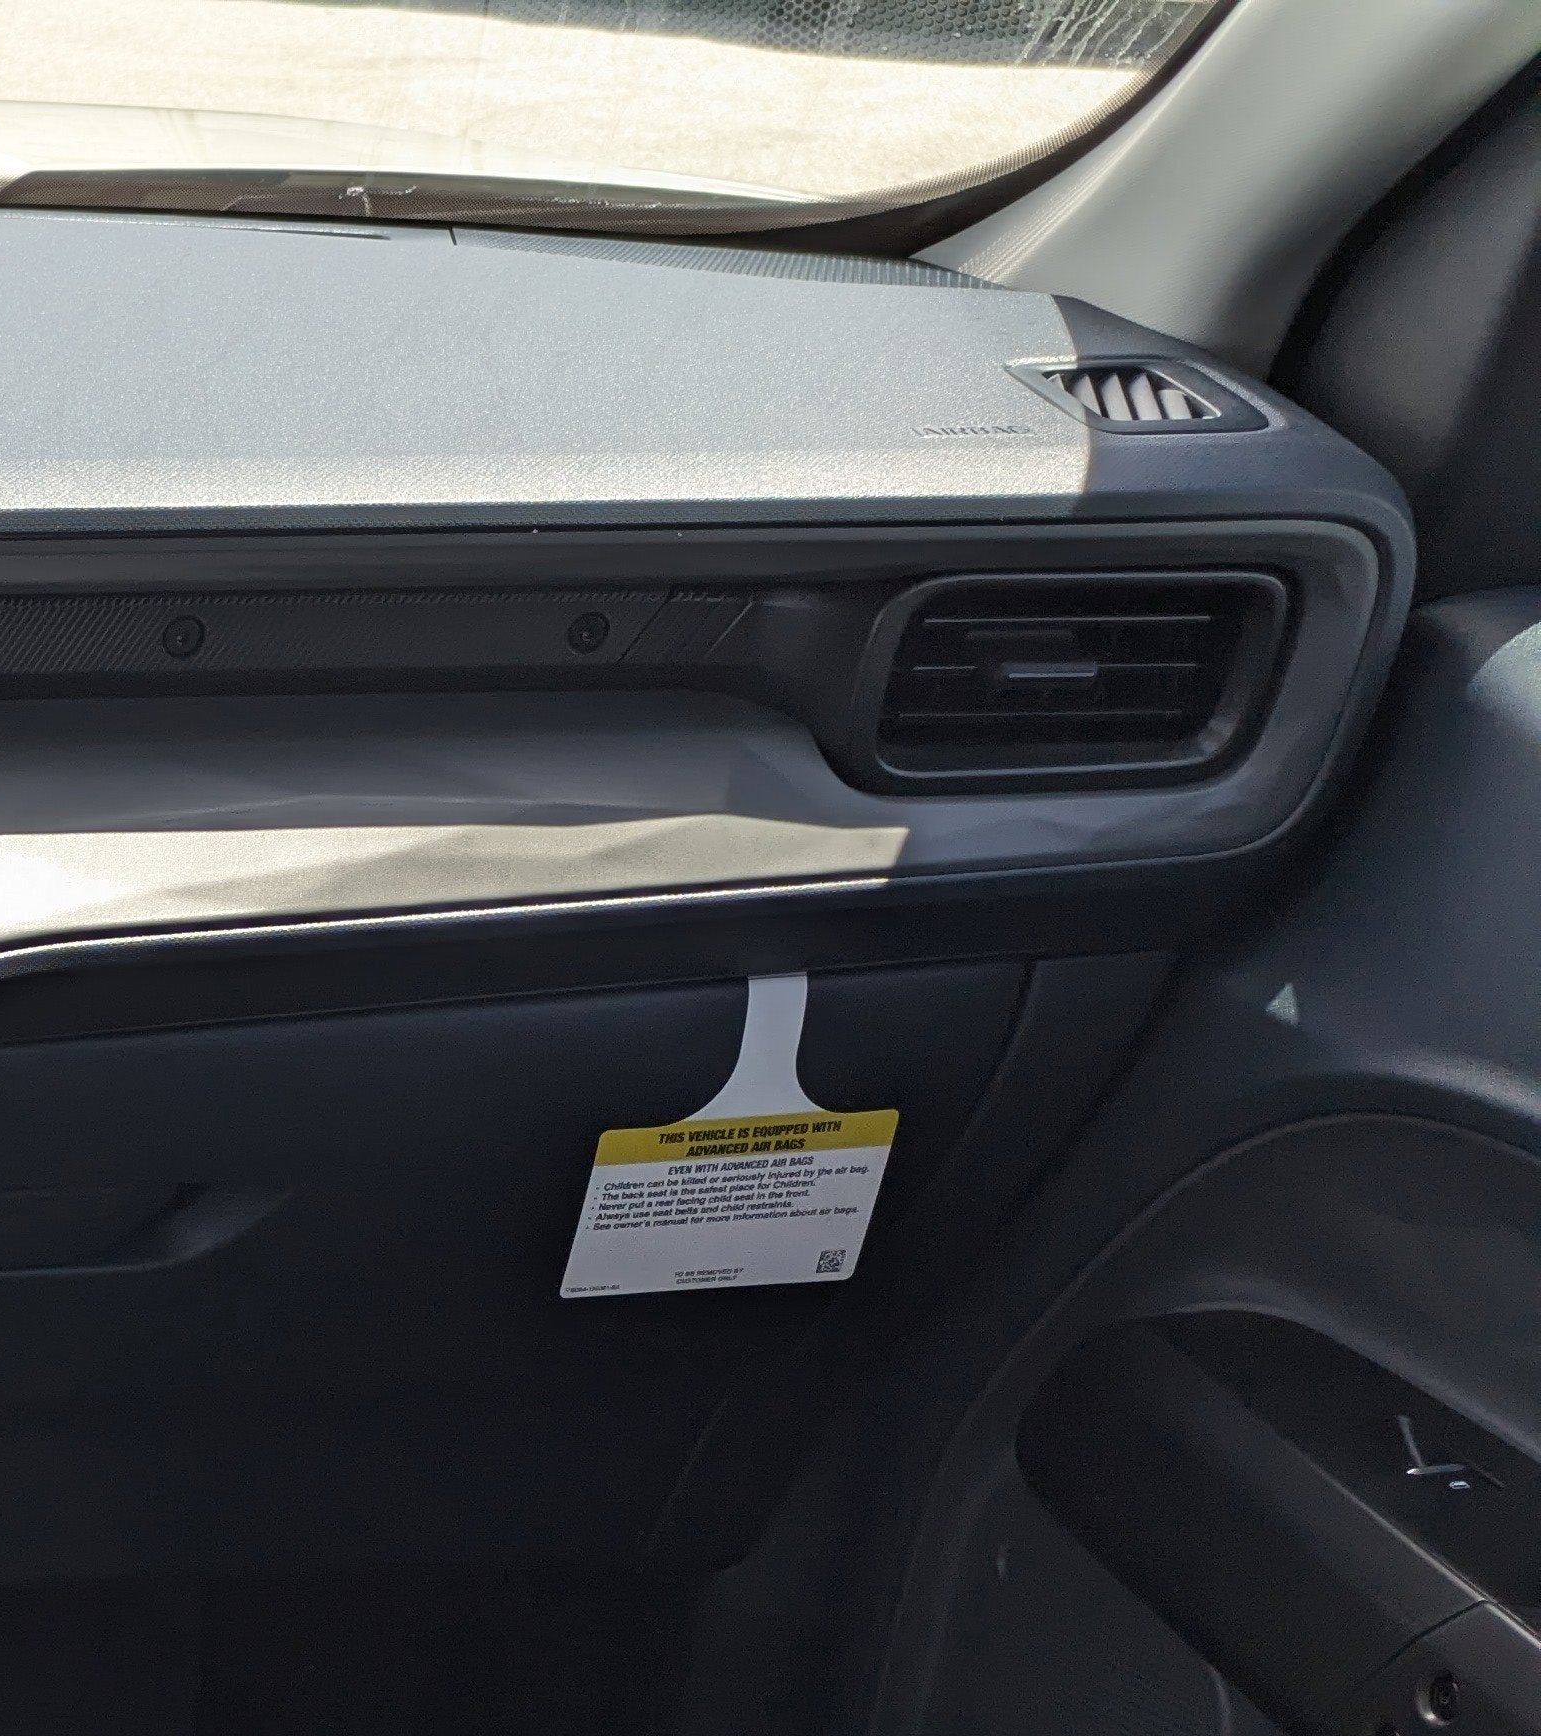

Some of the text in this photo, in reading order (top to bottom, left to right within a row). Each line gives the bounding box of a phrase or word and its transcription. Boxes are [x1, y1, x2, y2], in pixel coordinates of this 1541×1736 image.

[659, 1120, 842, 1144] THIS VEHICLE IS EQUIPPED WITH
[685, 1138, 806, 1157] ADVANCED AIR BAGS
[668, 1156, 815, 1176] EVEN WITH ADVANCED AIR BAGS
[604, 1181, 645, 1191] Children
[646, 1180, 664, 1189] can
[667, 1179, 678, 1187] be
[681, 1177, 707, 1186] killed
[721, 1172, 765, 1183] seriously
[803, 1169, 816, 1178] by
[818, 1167, 833, 1177] the
[834, 1166, 848, 1175] air
[849, 1165, 870, 1175] bag.
[599, 1202, 626, 1211] Never
[628, 1201, 645, 1211] put
[655, 1199, 675, 1207] rear
[677, 1197, 706, 1206] facing
[708, 1194, 732, 1203] child
[734, 1193, 755, 1202] seat
[757, 1192, 766, 1200] in
[768, 1190, 783, 1199] the
[602, 1179, 816, 1201] The back seat is the safest place for Children.
[593, 1222, 611, 1231] See
[613, 1220, 651, 1230] owner's
[653, 1217, 688, 1227] manual
[690, 1216, 703, 1224] for
[706, 1215, 730, 1223] more
[732, 1210, 787, 1221] information
[789, 1208, 817, 1218] about
[819, 1207, 832, 1216] air
[595, 1213, 630, 1222] Always
[632, 1211, 650, 1219] use
[652, 1209, 673, 1217] seat
[674, 1207, 698, 1216] belts
[700, 1205, 718, 1213] and
[721, 1203, 745, 1212] child
